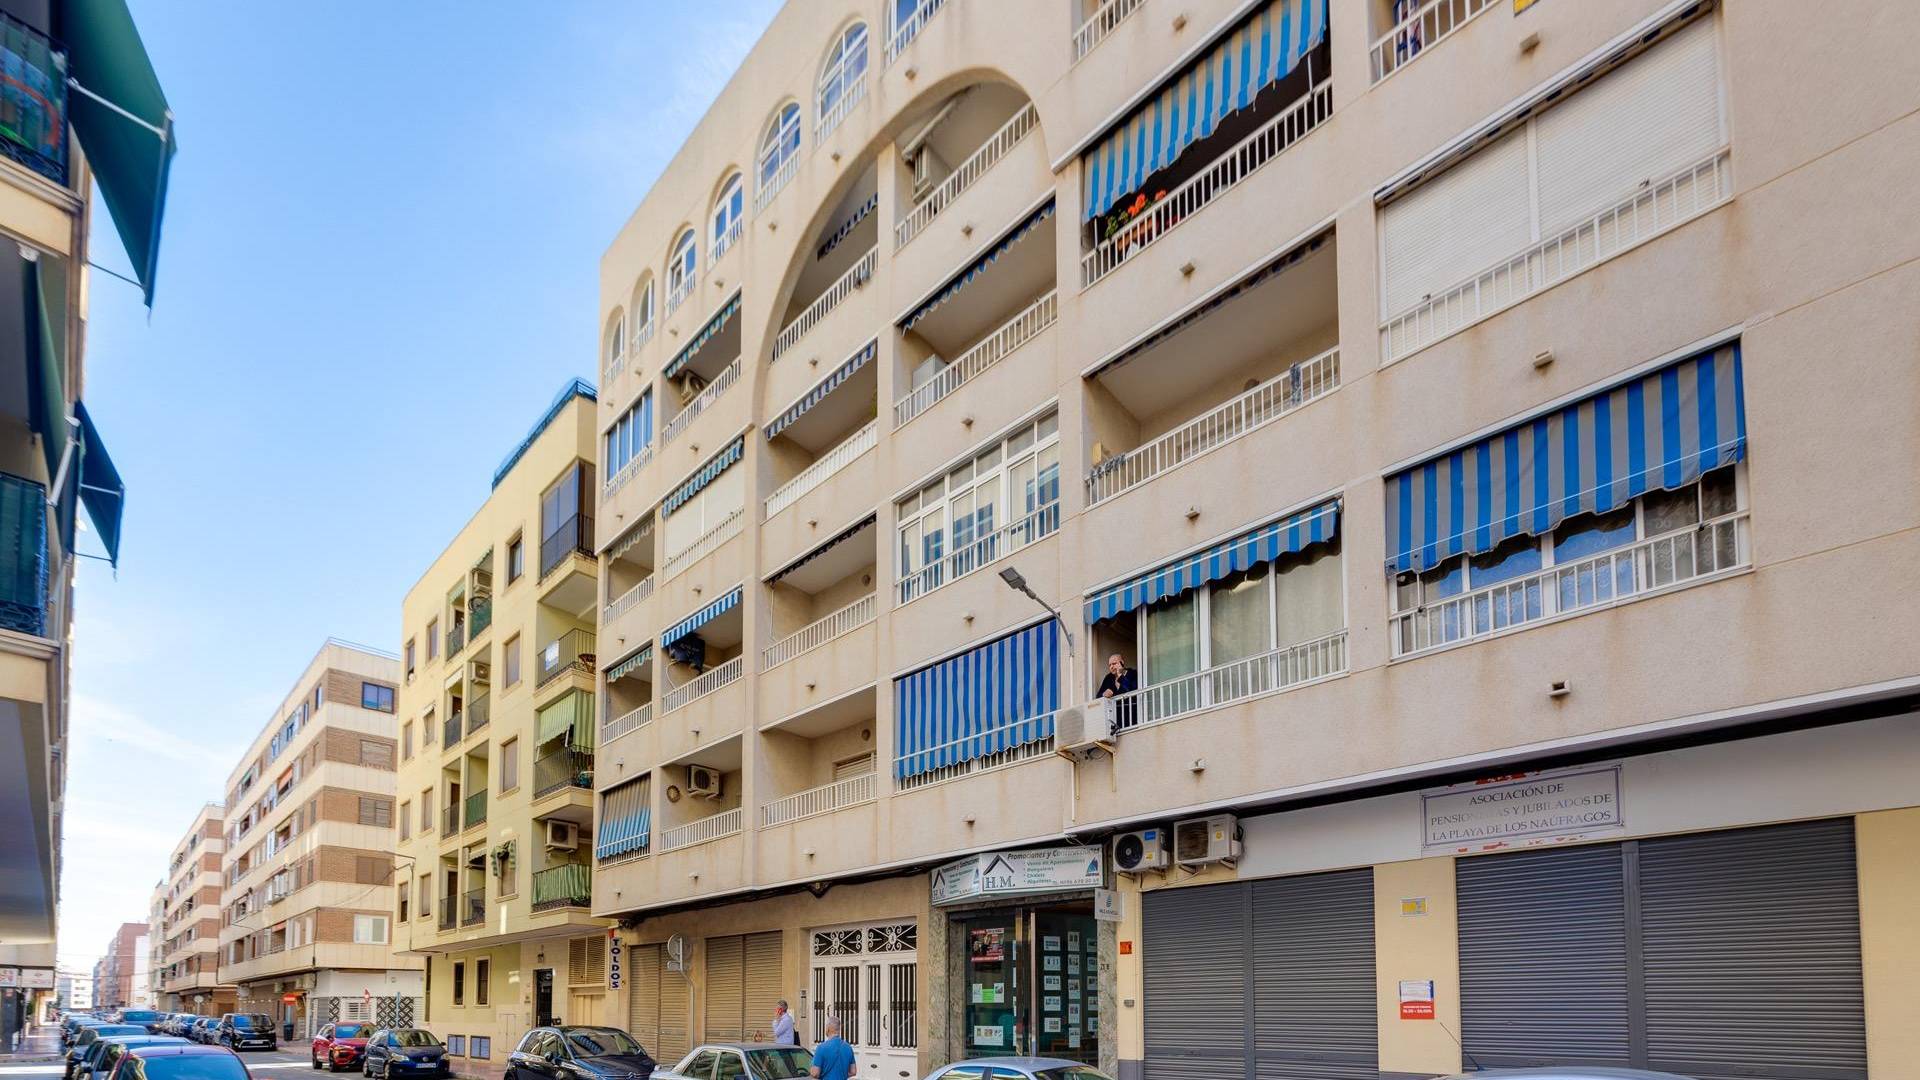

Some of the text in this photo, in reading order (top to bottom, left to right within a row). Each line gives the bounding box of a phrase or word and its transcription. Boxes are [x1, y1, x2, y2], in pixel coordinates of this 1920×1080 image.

[1470, 783, 1565, 805] ASOCIACIÓN DE
[1512, 805, 1520, 815] Y
[1594, 793, 1612, 804] DE
[1433, 831, 1447, 841] LA
[1449, 827, 1484, 839] PLAYA
[1487, 824, 1502, 835] DE
[1505, 820, 1528, 832] LOS
[611, 938, 621, 988] TOLDOS
